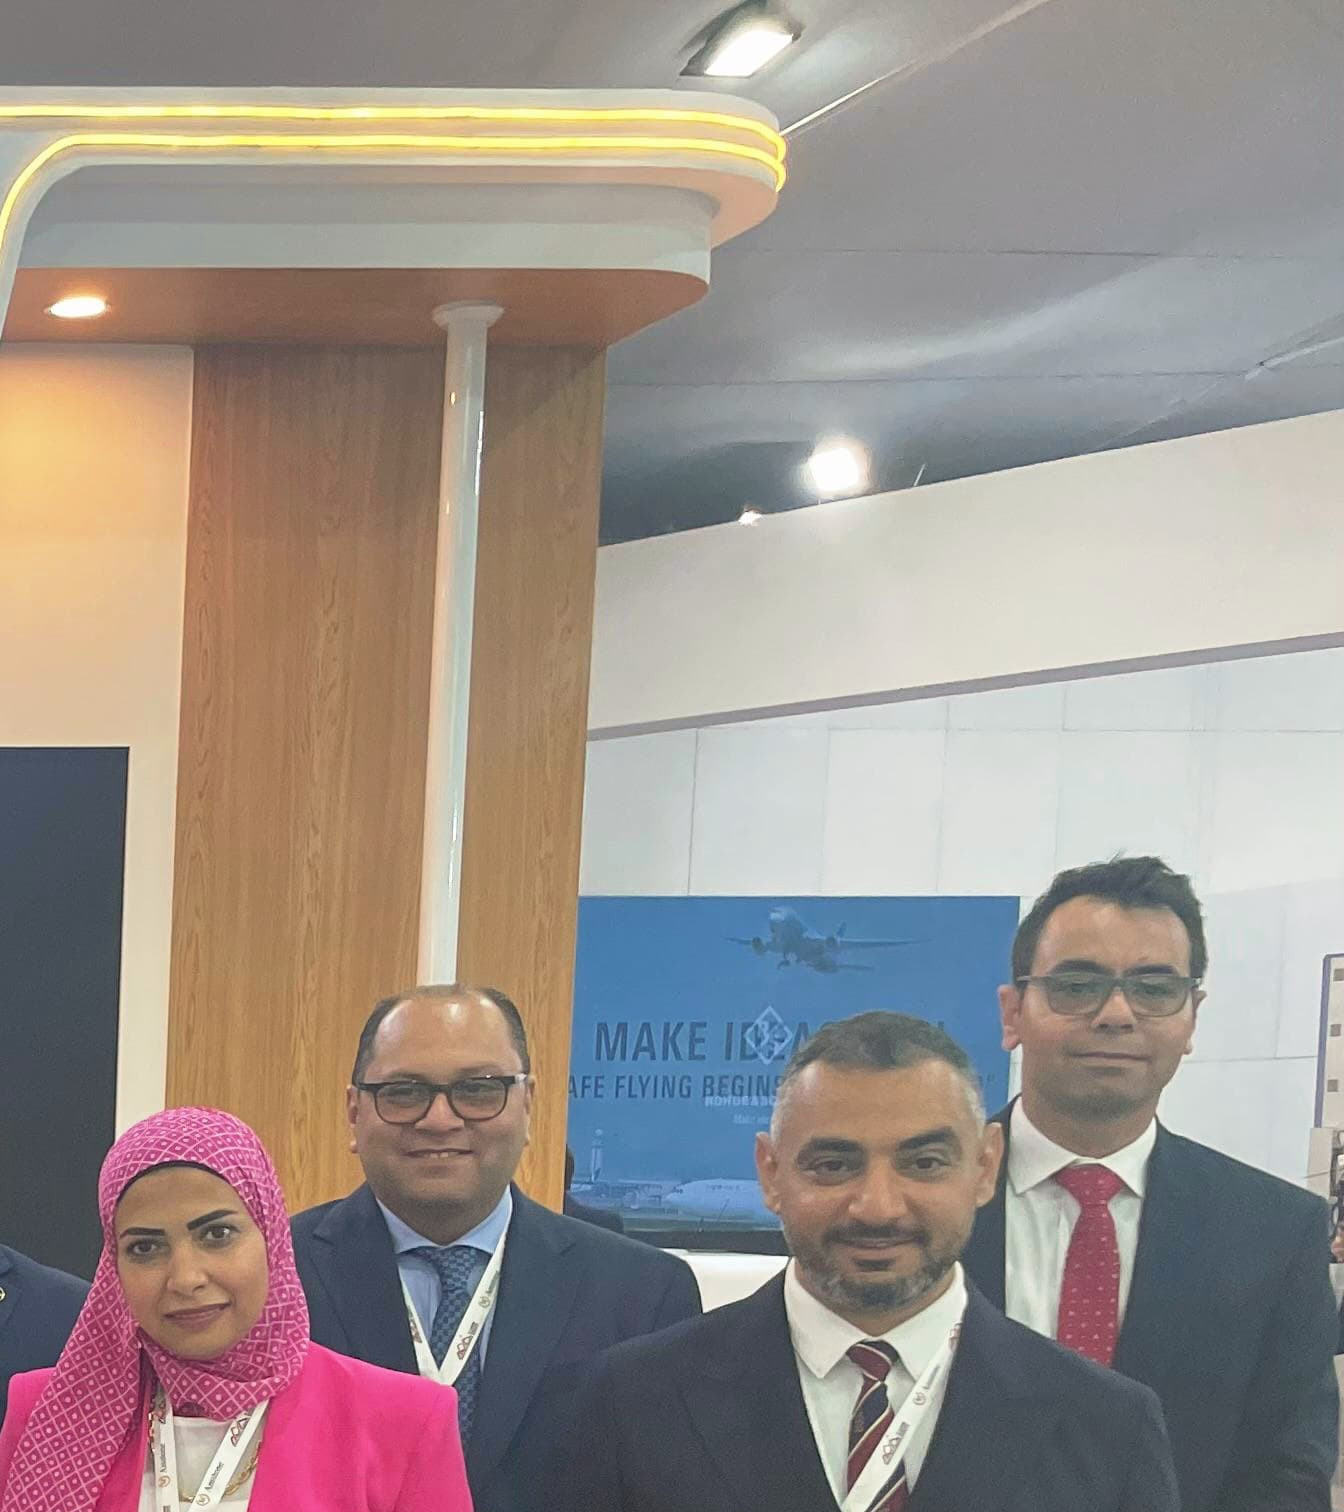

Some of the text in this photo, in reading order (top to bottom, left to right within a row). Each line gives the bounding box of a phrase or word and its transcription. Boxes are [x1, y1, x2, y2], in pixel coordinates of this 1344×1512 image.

[594, 1021, 708, 1062] MAKE
[568, 1075, 605, 1099] AFE
[614, 1075, 692, 1099] FLYING
